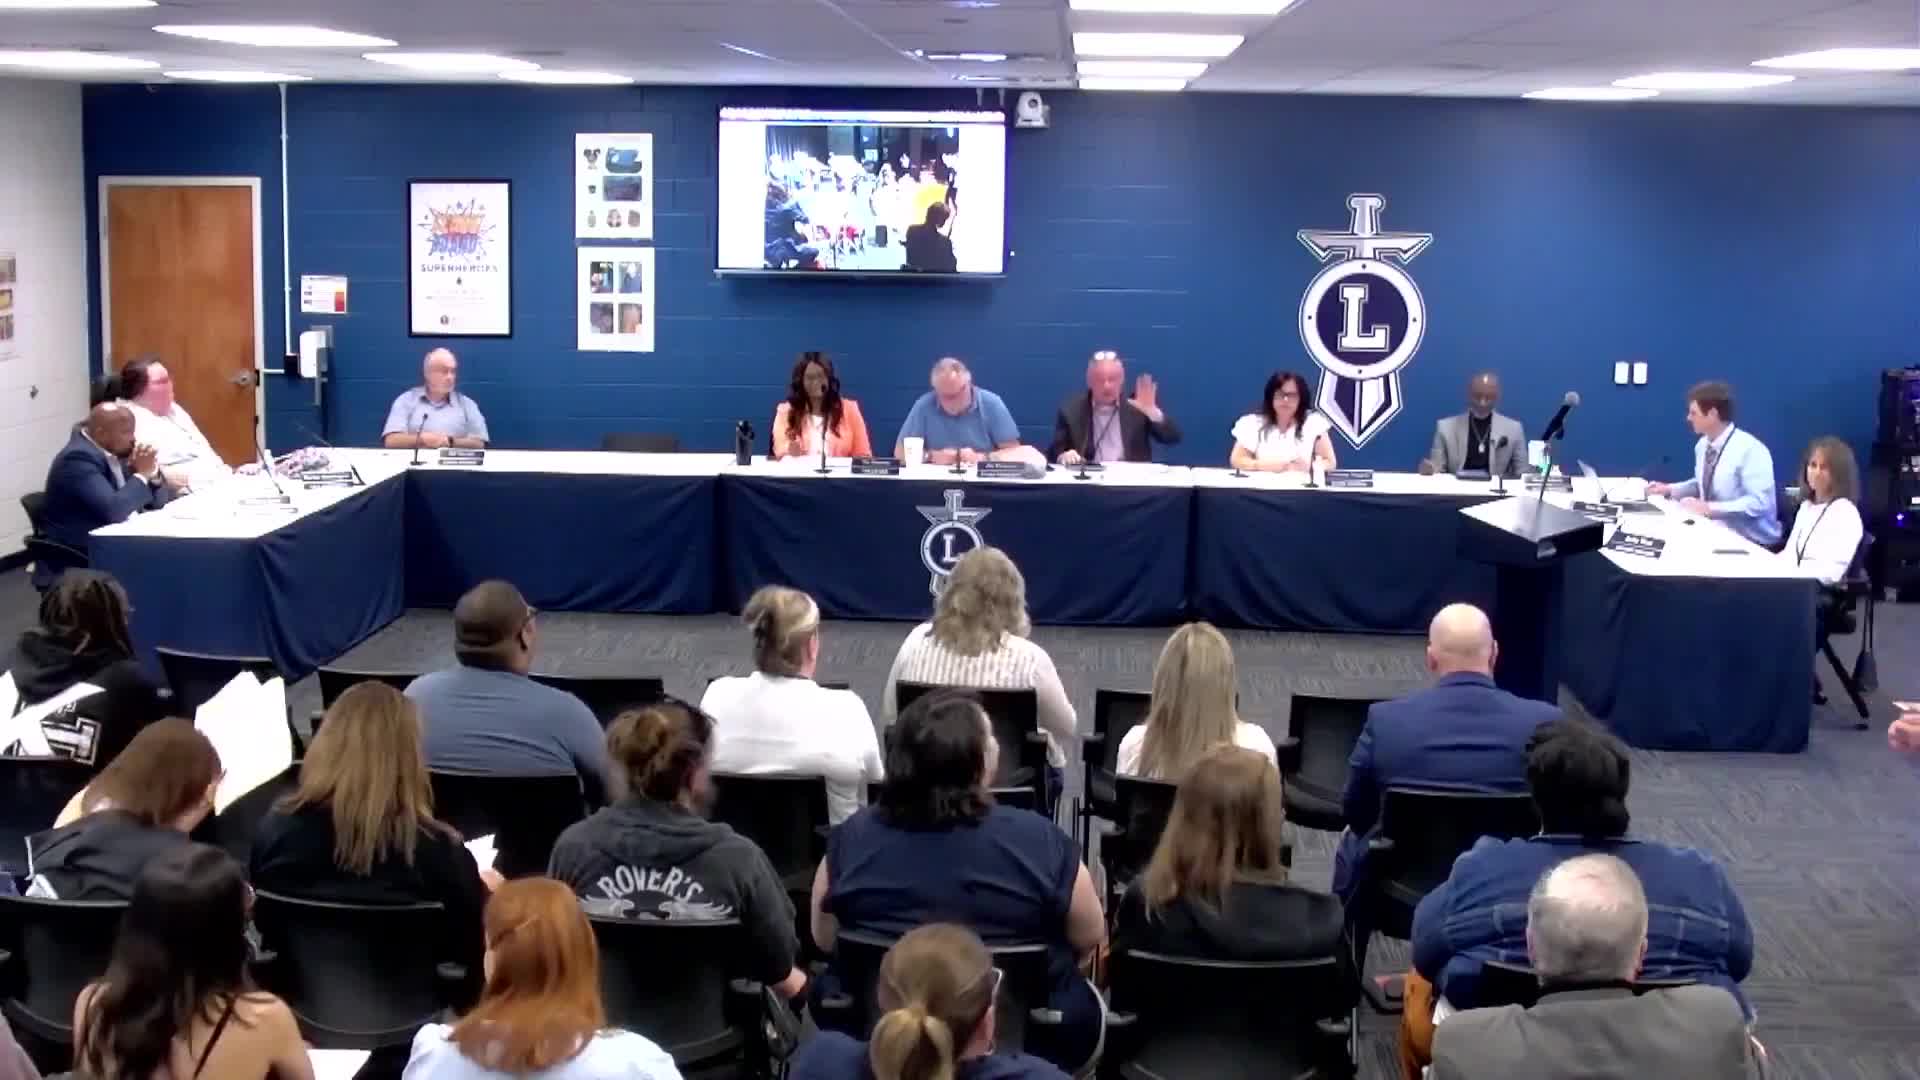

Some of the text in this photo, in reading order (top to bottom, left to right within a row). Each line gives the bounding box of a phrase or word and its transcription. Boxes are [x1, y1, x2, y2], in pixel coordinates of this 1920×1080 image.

[1337, 282, 1390, 352] L
[942, 534, 961, 562] L
[597, 865, 704, 902] ROVER'S
